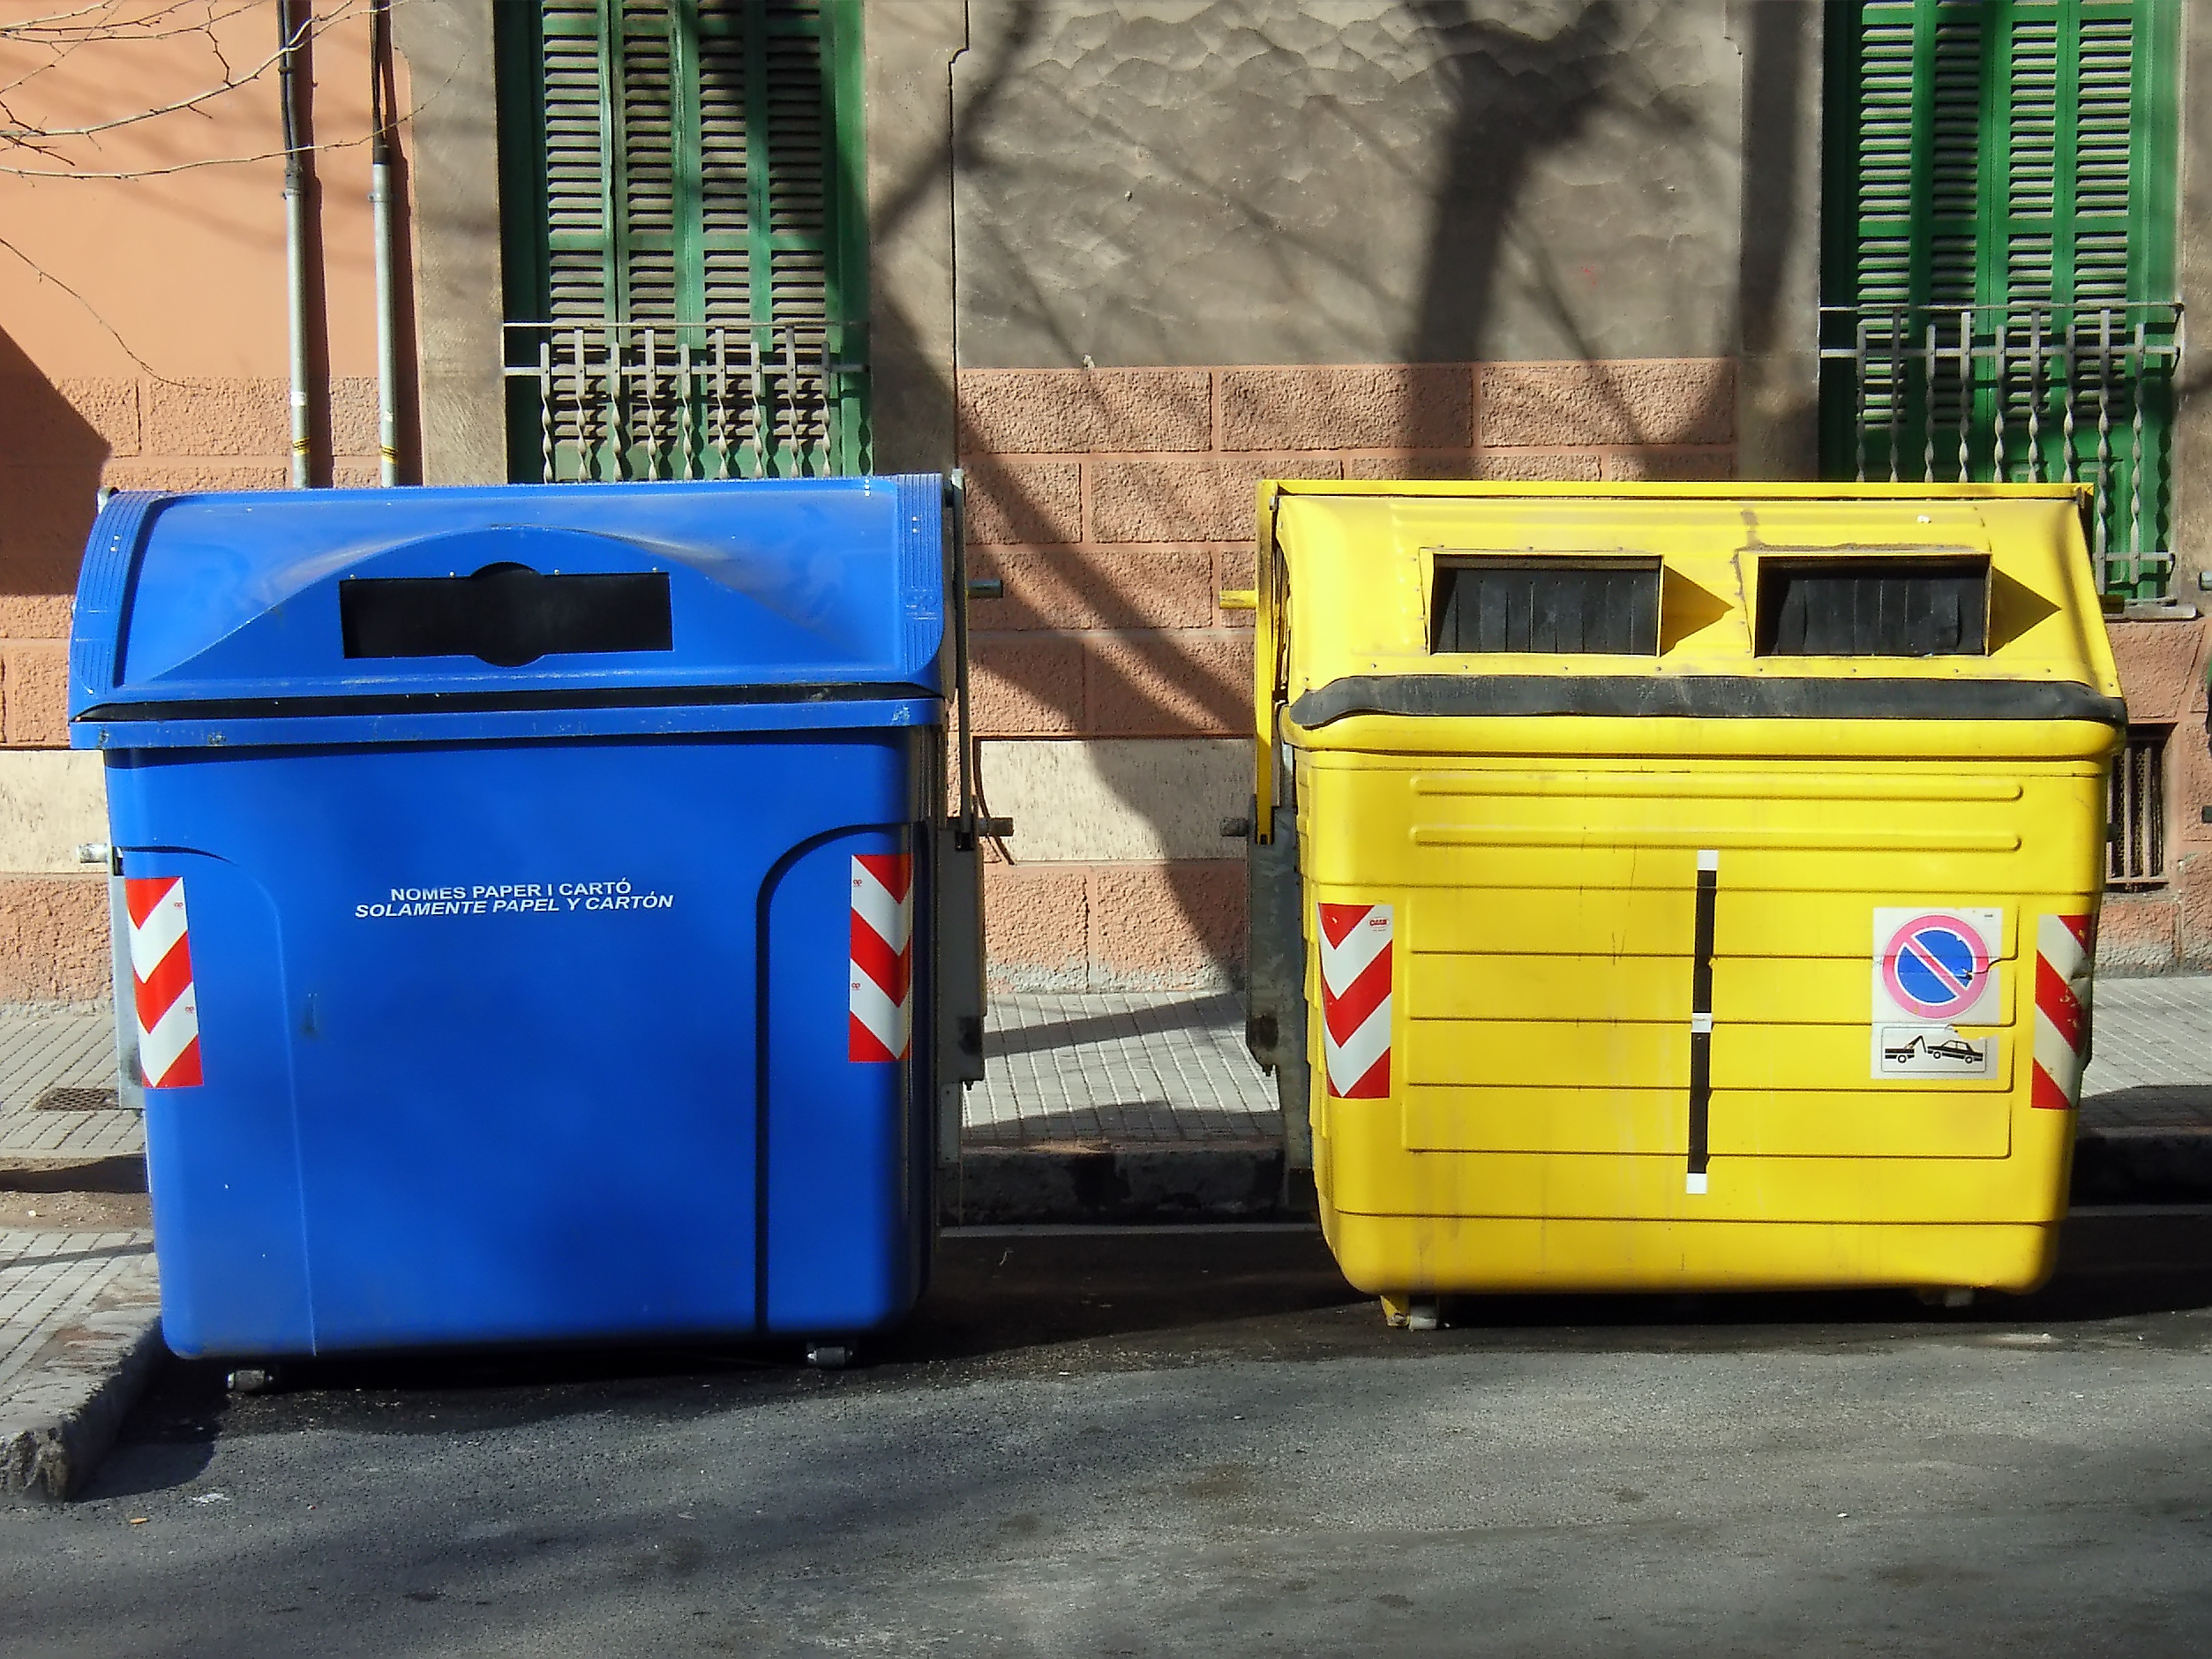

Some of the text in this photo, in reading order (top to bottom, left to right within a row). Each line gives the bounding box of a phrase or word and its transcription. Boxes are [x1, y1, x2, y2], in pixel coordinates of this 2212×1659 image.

[391, 876, 633, 902] NOMES PAPER I CARTÓ
[355, 890, 674, 919] SOLAMENTE PAPEL Y CARTÓN
